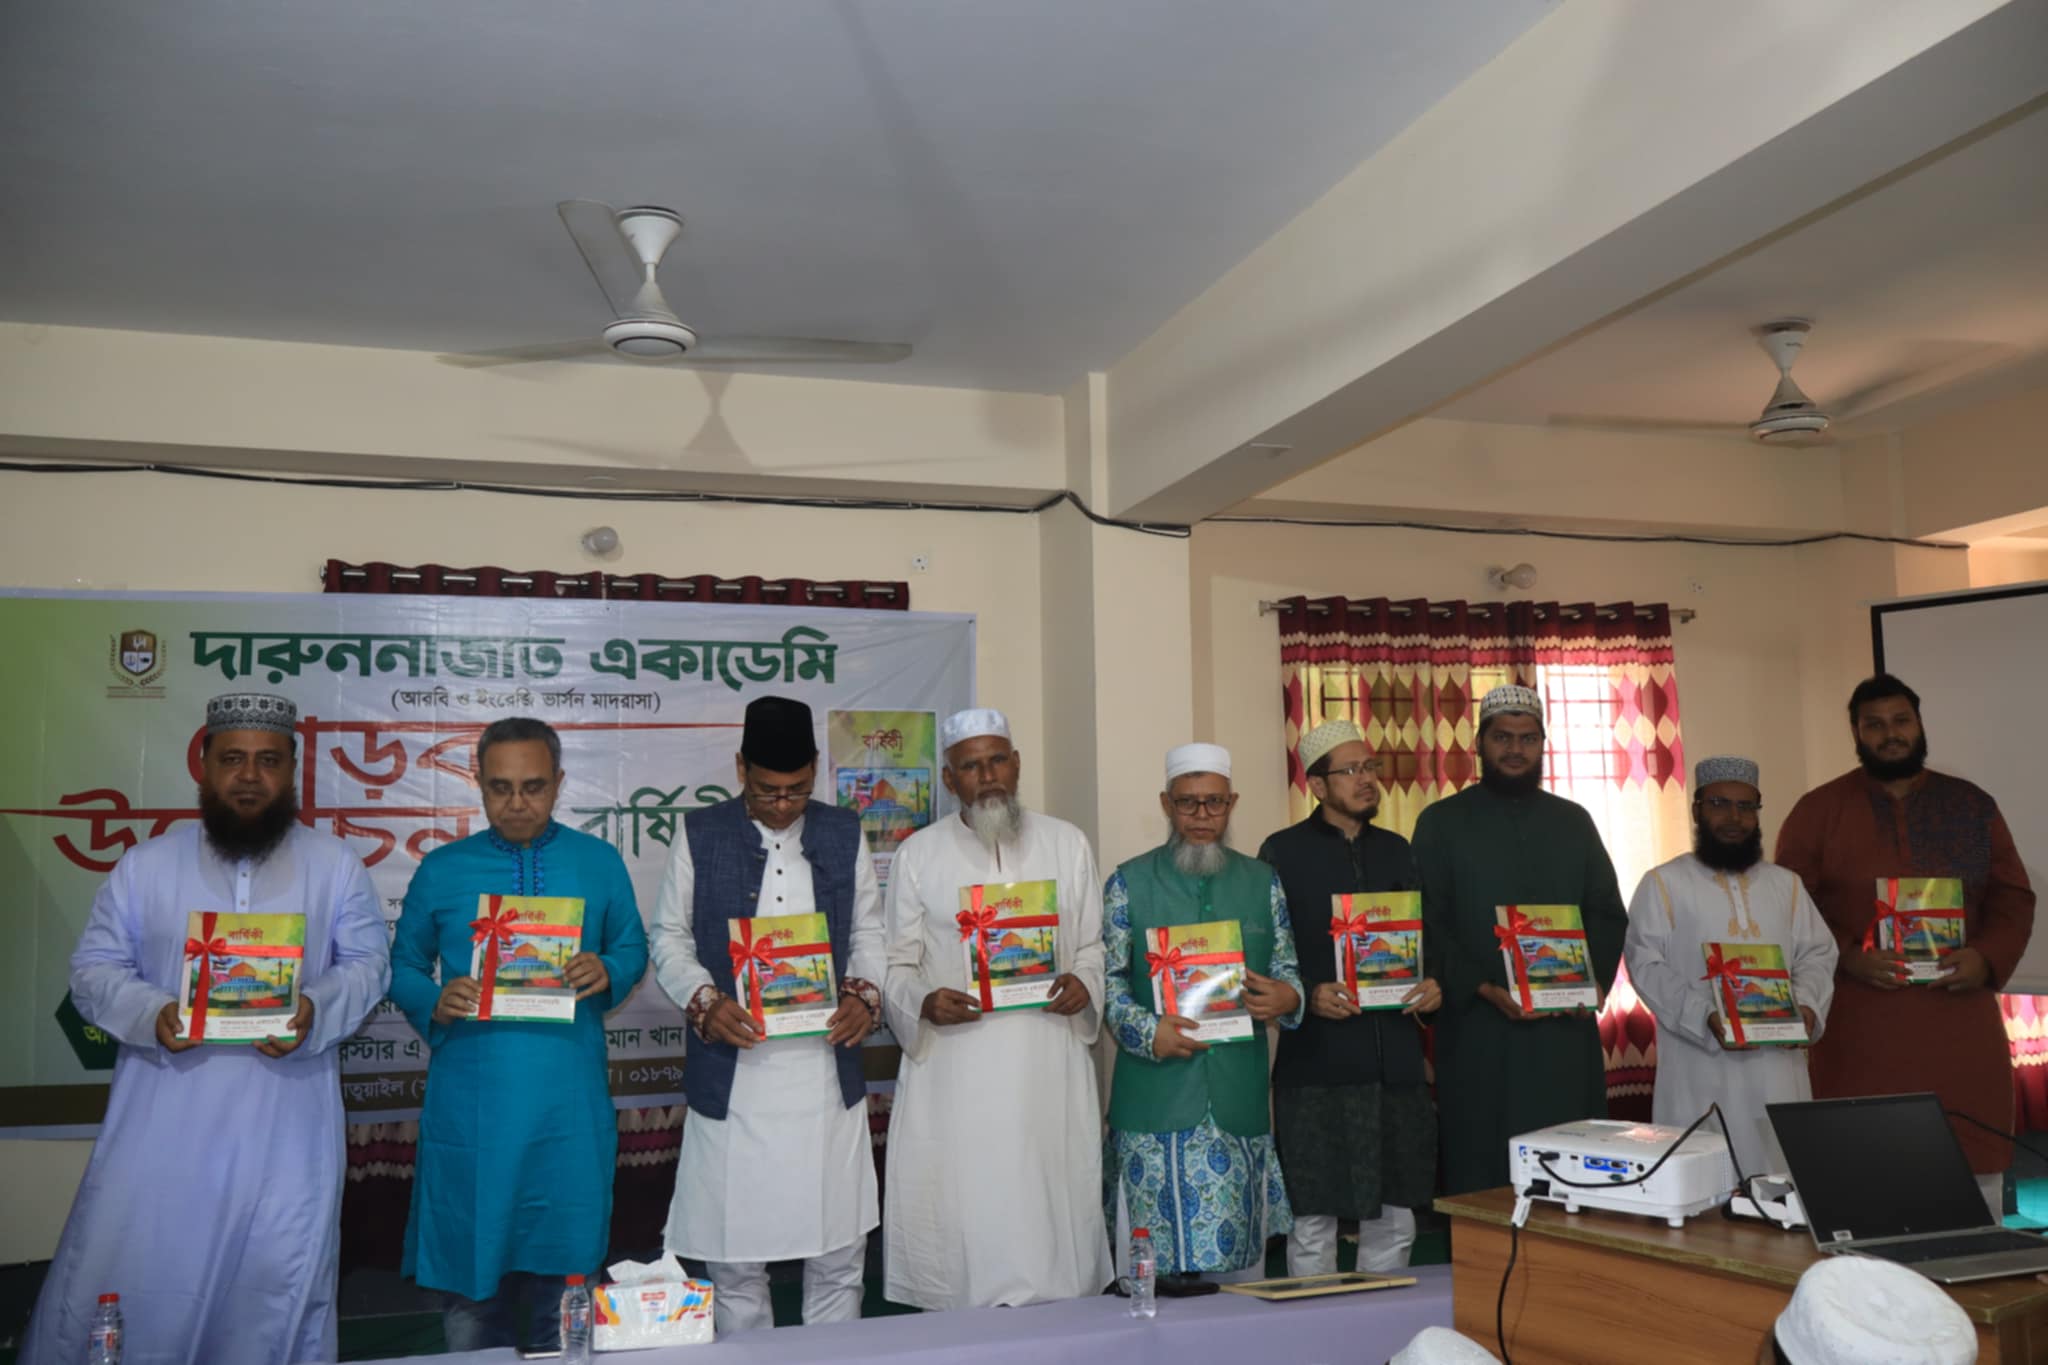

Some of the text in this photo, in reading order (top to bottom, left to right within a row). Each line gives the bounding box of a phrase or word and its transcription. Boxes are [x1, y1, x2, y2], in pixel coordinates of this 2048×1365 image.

[190, 625, 838, 691] দারুননাজাত একাডেমি
[391, 686, 449, 712] (আরবি
[542, 688, 585, 708] ভার্সন
[592, 690, 661, 713] মাদরাসা)
[649, 1025, 684, 1047] খান
